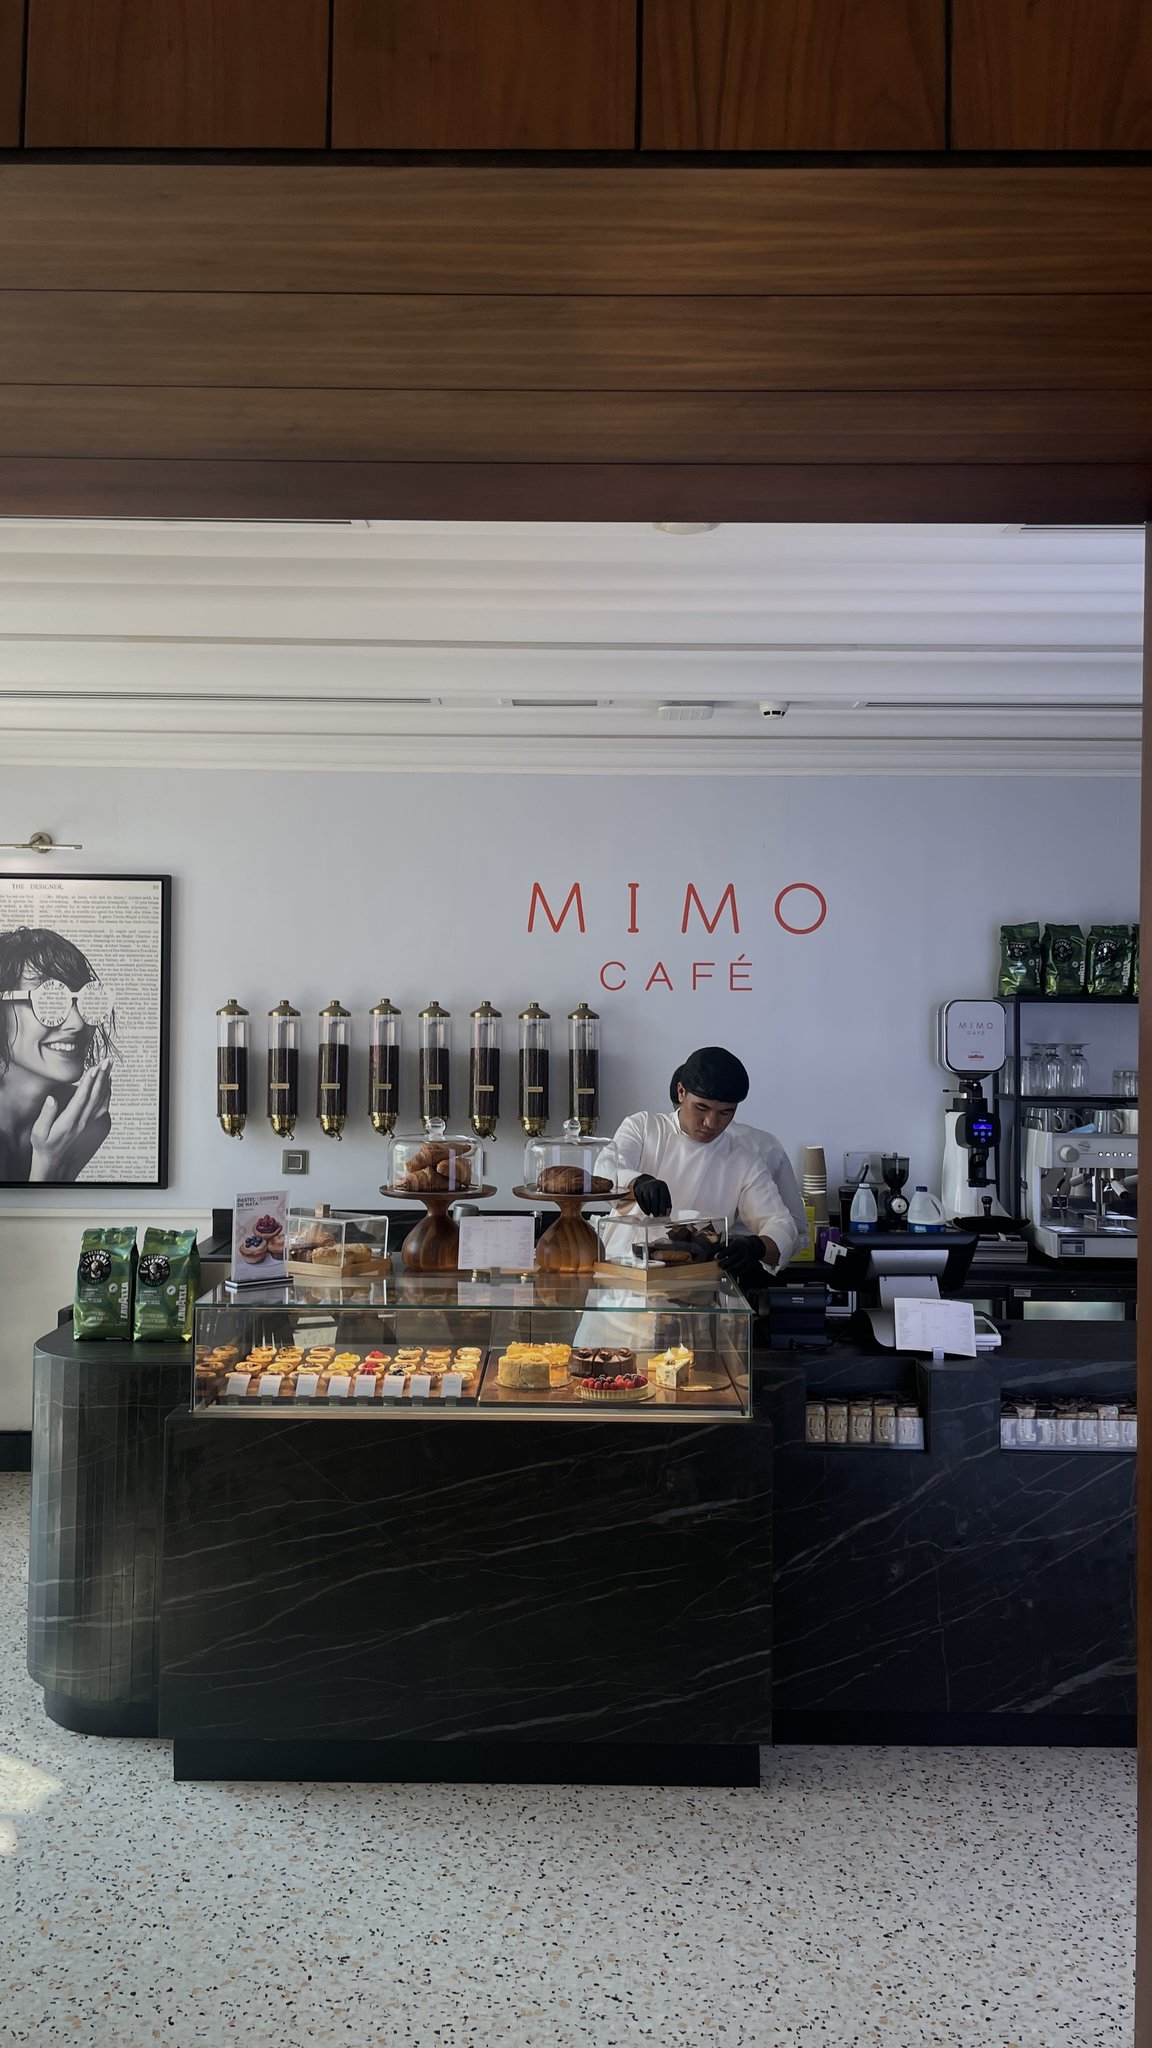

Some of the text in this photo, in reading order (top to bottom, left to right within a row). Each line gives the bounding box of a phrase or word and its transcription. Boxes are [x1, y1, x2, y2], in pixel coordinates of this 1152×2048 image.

[527, 882, 827, 935] MIMO
[600, 953, 753, 991] CAFÉ
[959, 1022, 994, 1030] MIMO
[118, 1281, 129, 1319] LAVAZZA
[175, 1284, 187, 1322] LAVAZZA
